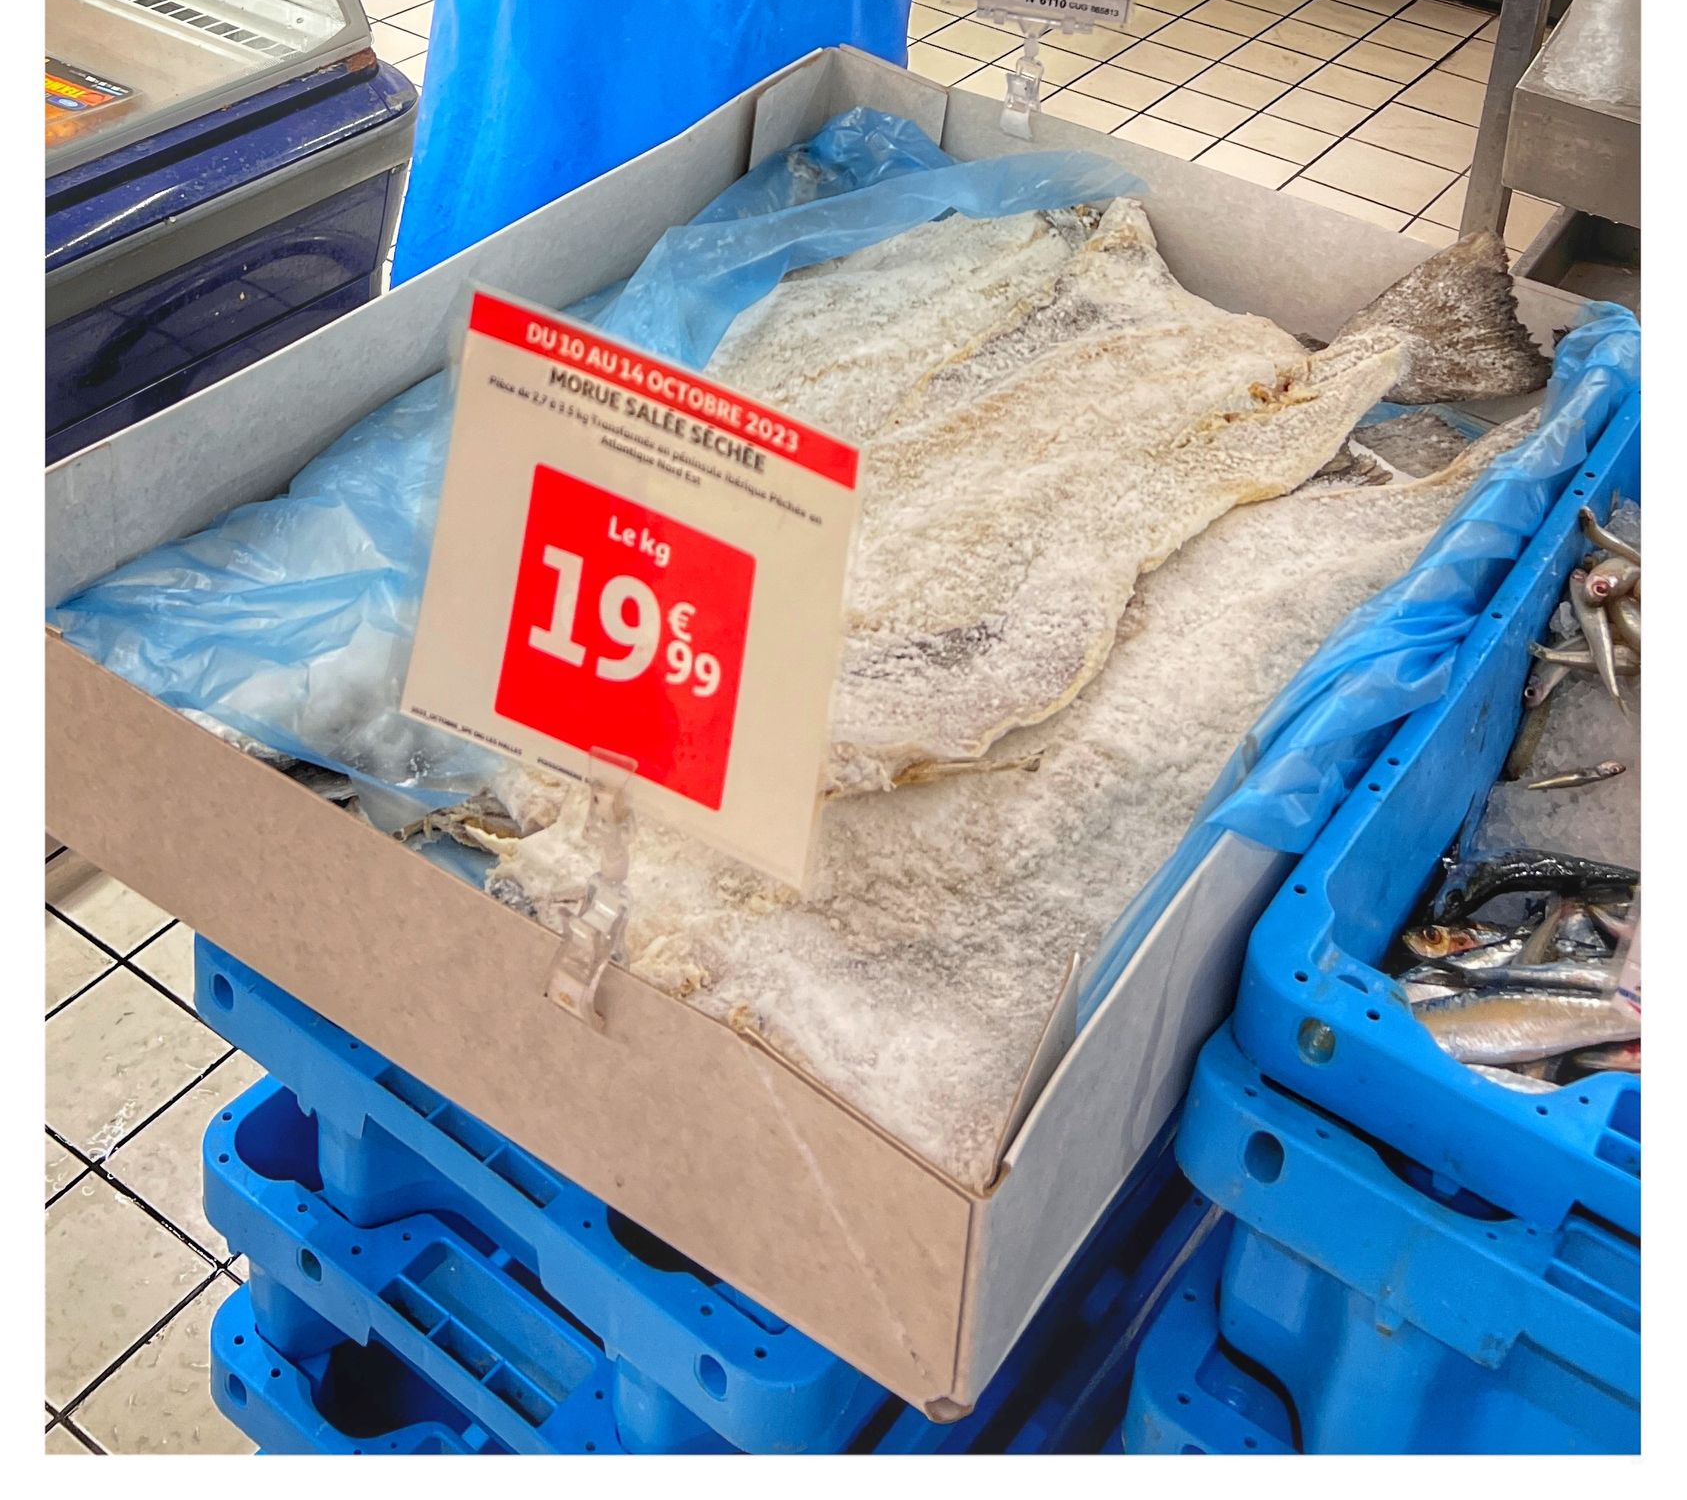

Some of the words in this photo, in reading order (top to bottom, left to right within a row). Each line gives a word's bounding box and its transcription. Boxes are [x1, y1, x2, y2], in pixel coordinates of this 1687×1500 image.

[526, 321, 556, 349] DU
[560, 334, 584, 358] 10
[586, 345, 617, 373] AU
[620, 358, 644, 385] 14
[646, 369, 743, 428] OCTOBRE
[745, 410, 799, 453] 2023
[550, 365, 621, 411] MORUE
[625, 396, 687, 438] SALÉE
[691, 422, 766, 474] SÉCHÉE
[601, 434, 654, 466] Atlantique
[657, 460, 682, 477] Nord
[608, 515, 636, 547] Le
[639, 528, 671, 568] kg
[528, 544, 661, 682] 19
[668, 602, 696, 642] €
[665, 640, 721, 697] 99
